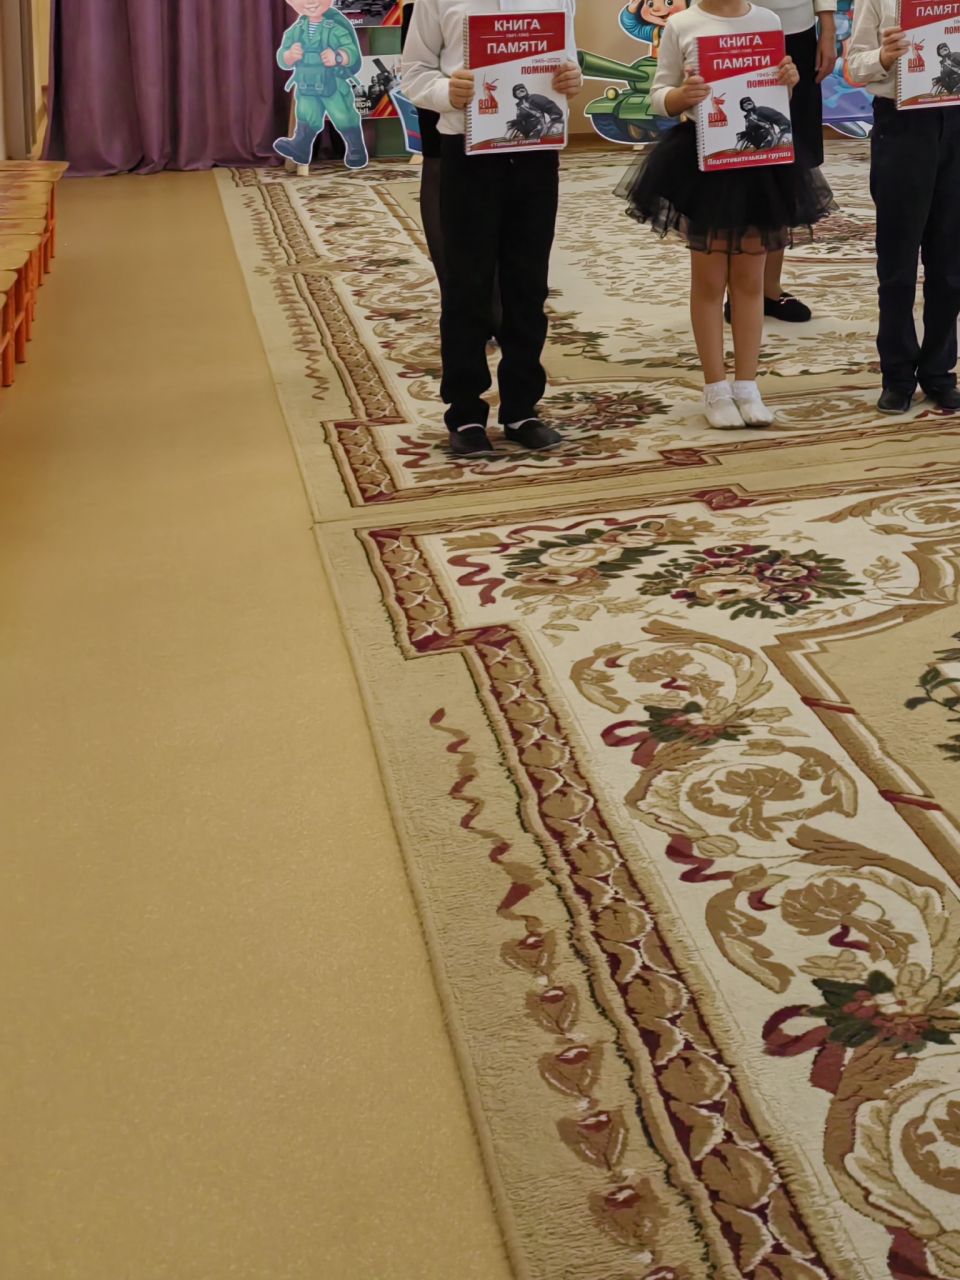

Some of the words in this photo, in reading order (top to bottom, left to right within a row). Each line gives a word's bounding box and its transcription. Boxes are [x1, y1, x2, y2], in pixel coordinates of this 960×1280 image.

[494, 19, 541, 32] КНИГА
[487, 40, 547, 55] ПАМЯТИ
[719, 34, 763, 49] КНИГА
[713, 55, 771, 70] ПАМЯТИ
[768, 151, 791, 160] группа
